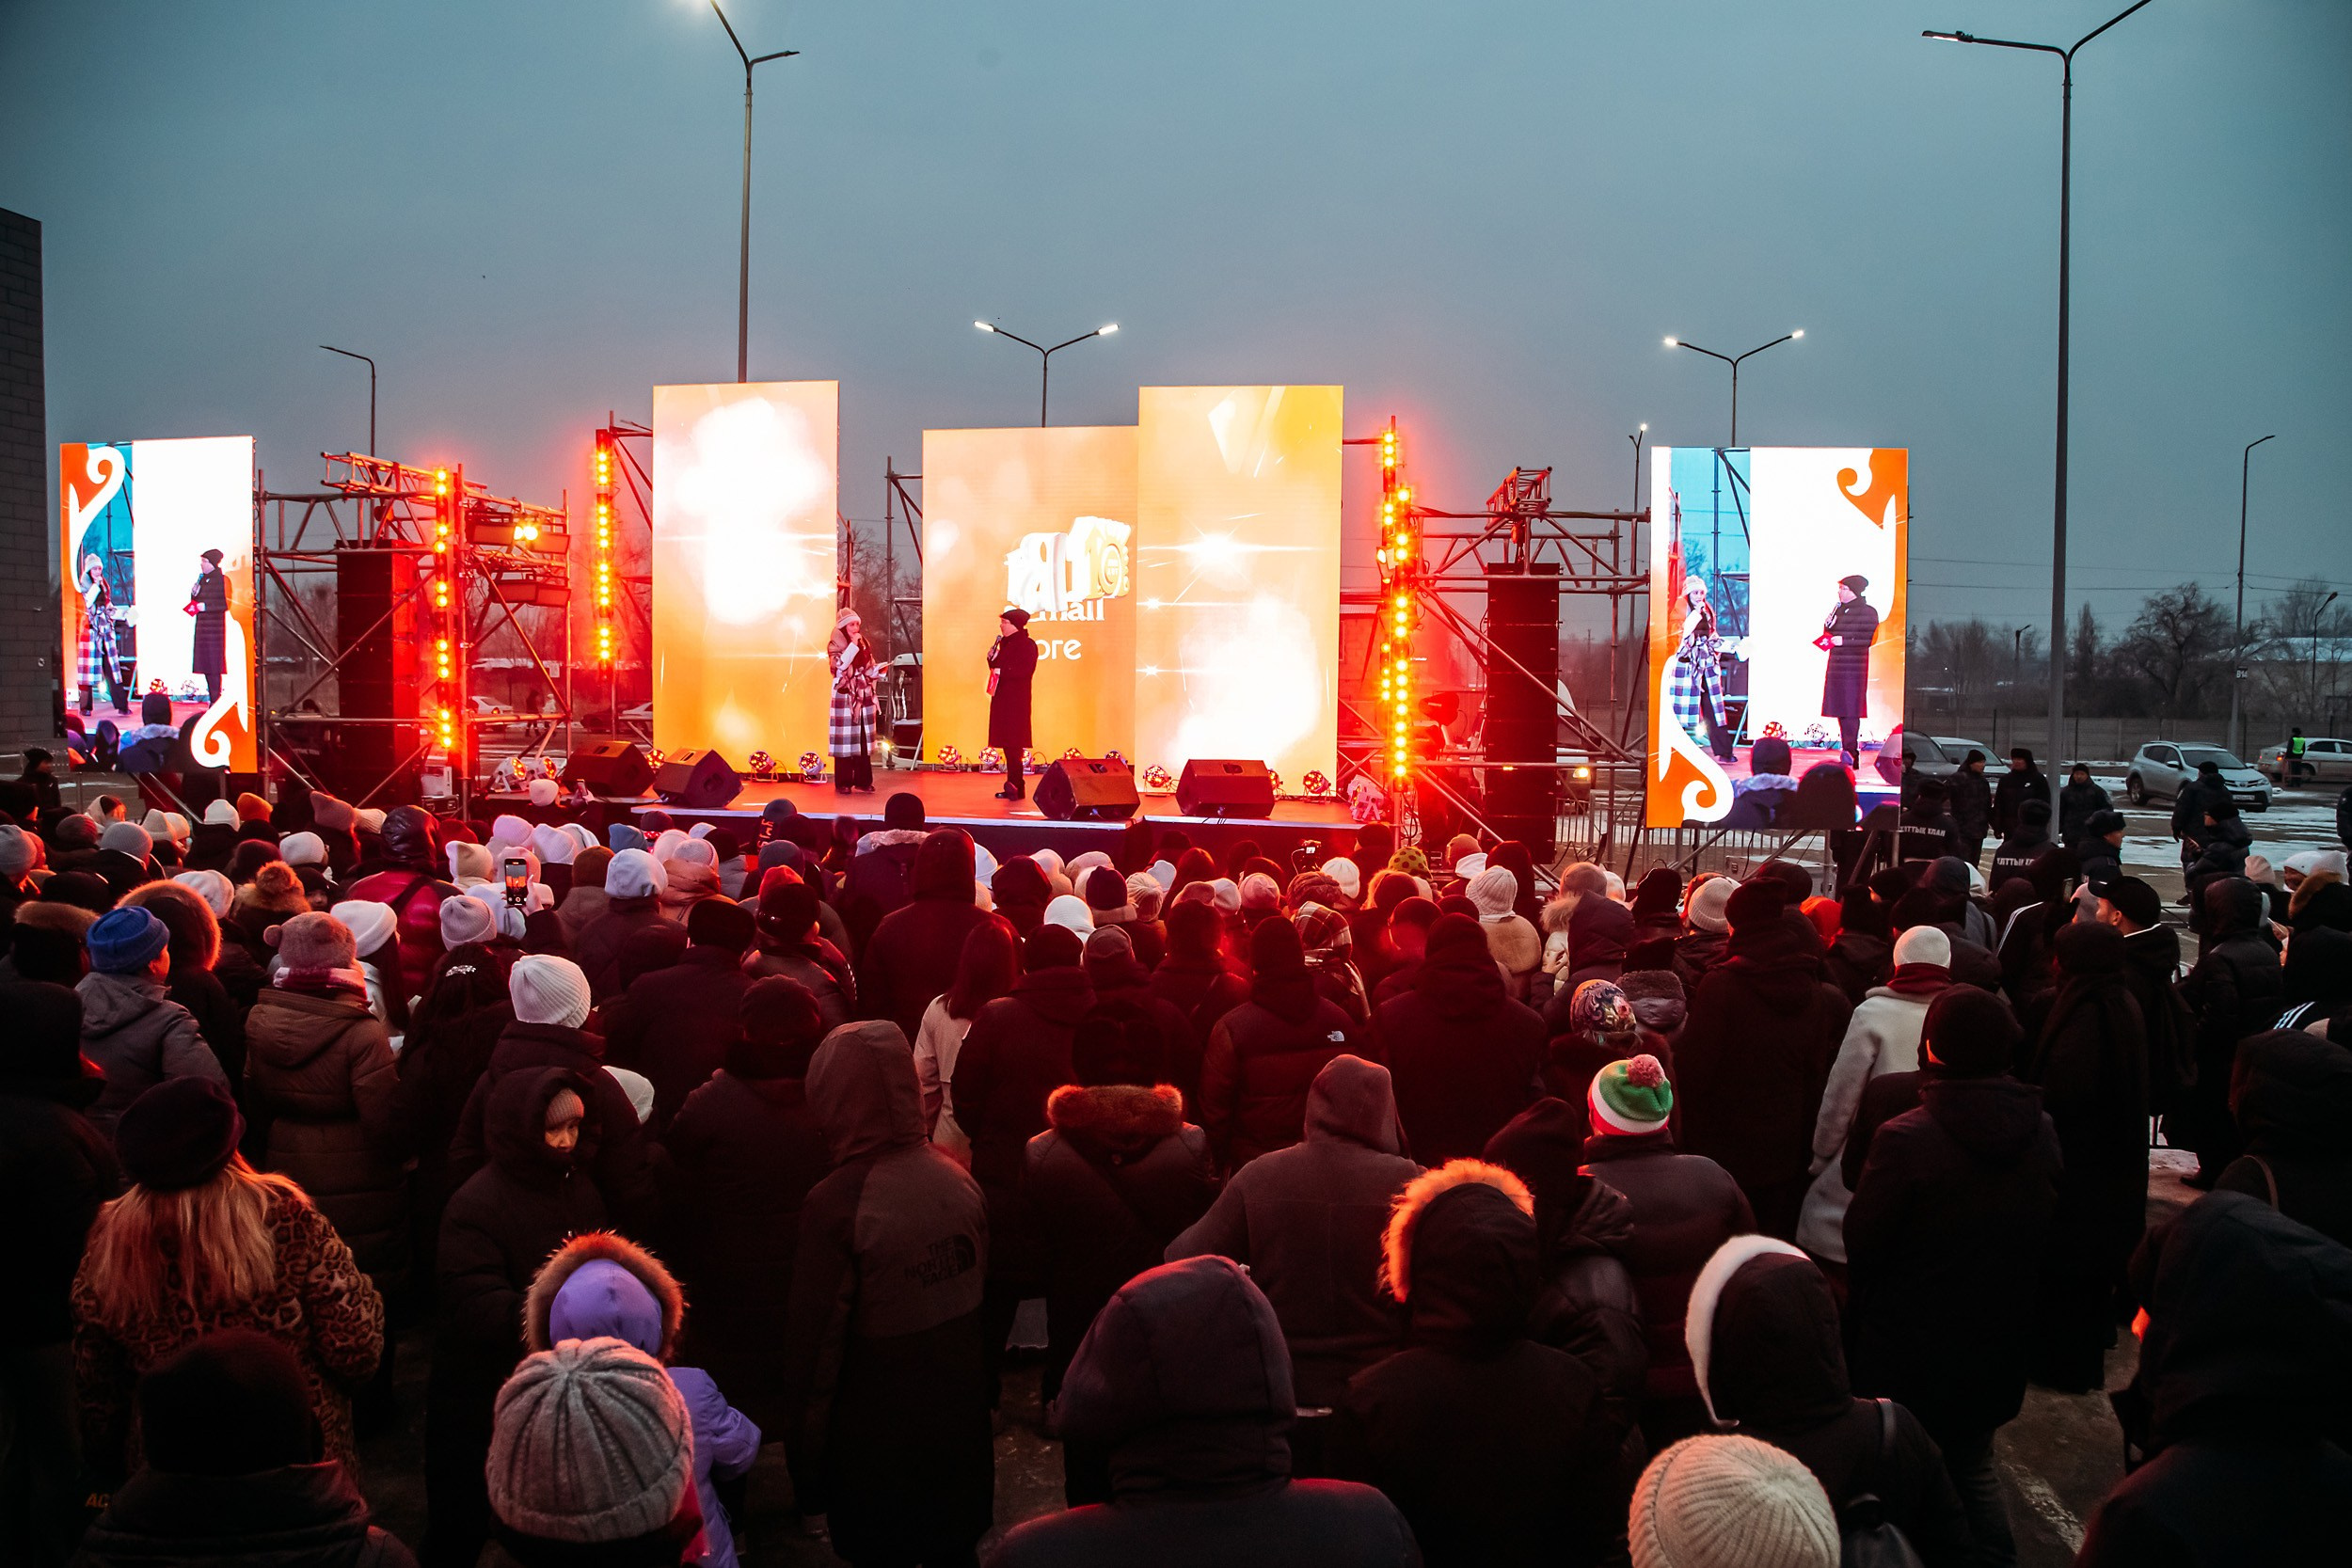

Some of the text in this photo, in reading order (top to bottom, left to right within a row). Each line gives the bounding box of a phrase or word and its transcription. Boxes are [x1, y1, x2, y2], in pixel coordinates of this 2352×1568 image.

[926, 1237, 955, 1257] THE
[904, 1253, 957, 1279] NORTH
[922, 1264, 958, 1289] FACE
